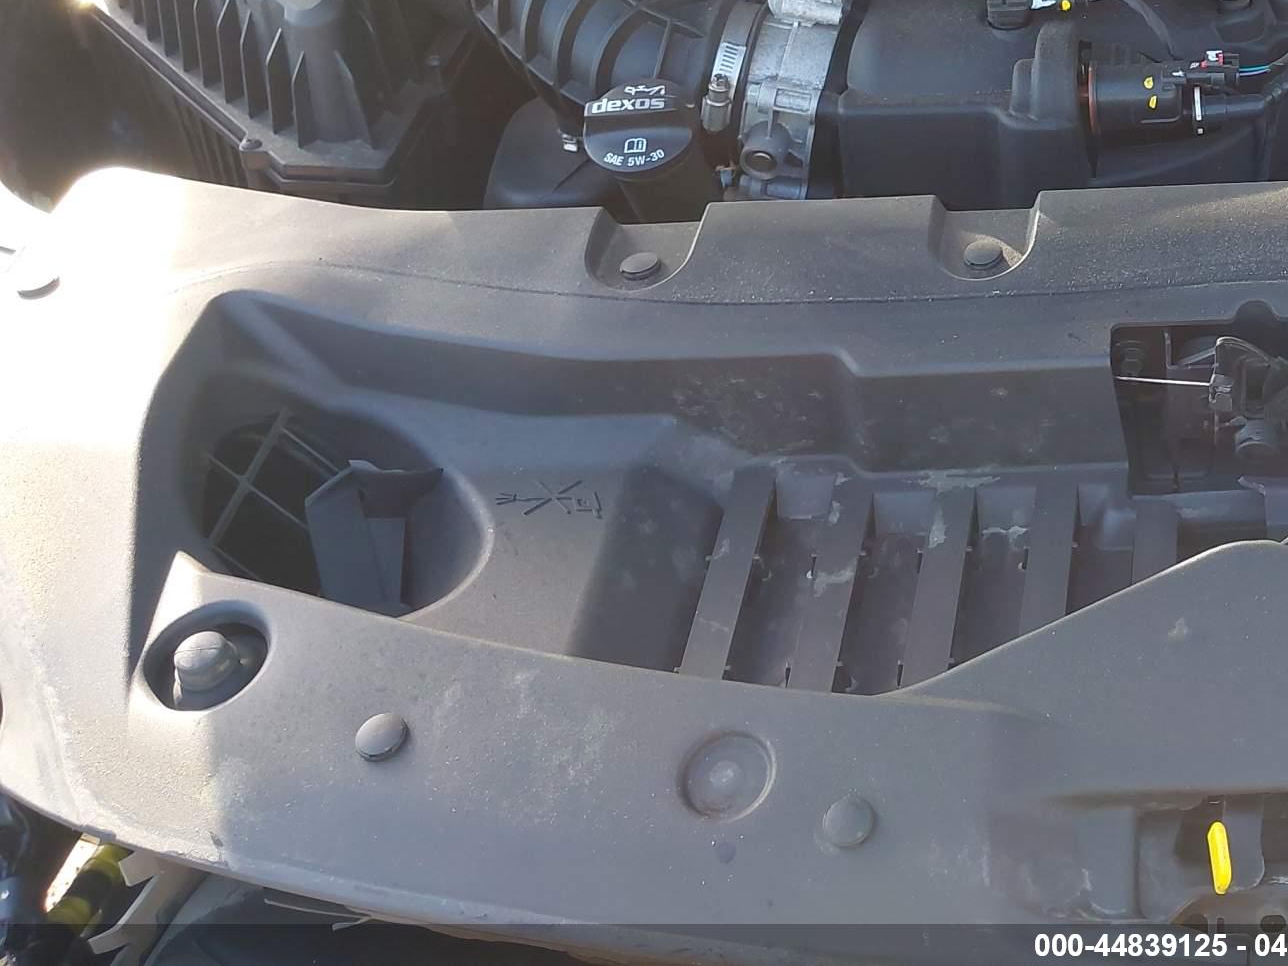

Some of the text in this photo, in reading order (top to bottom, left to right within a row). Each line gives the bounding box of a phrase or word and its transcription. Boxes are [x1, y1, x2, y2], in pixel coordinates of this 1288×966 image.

[591, 98, 665, 114] dexos
[603, 149, 665, 167] SAE 5W-30
